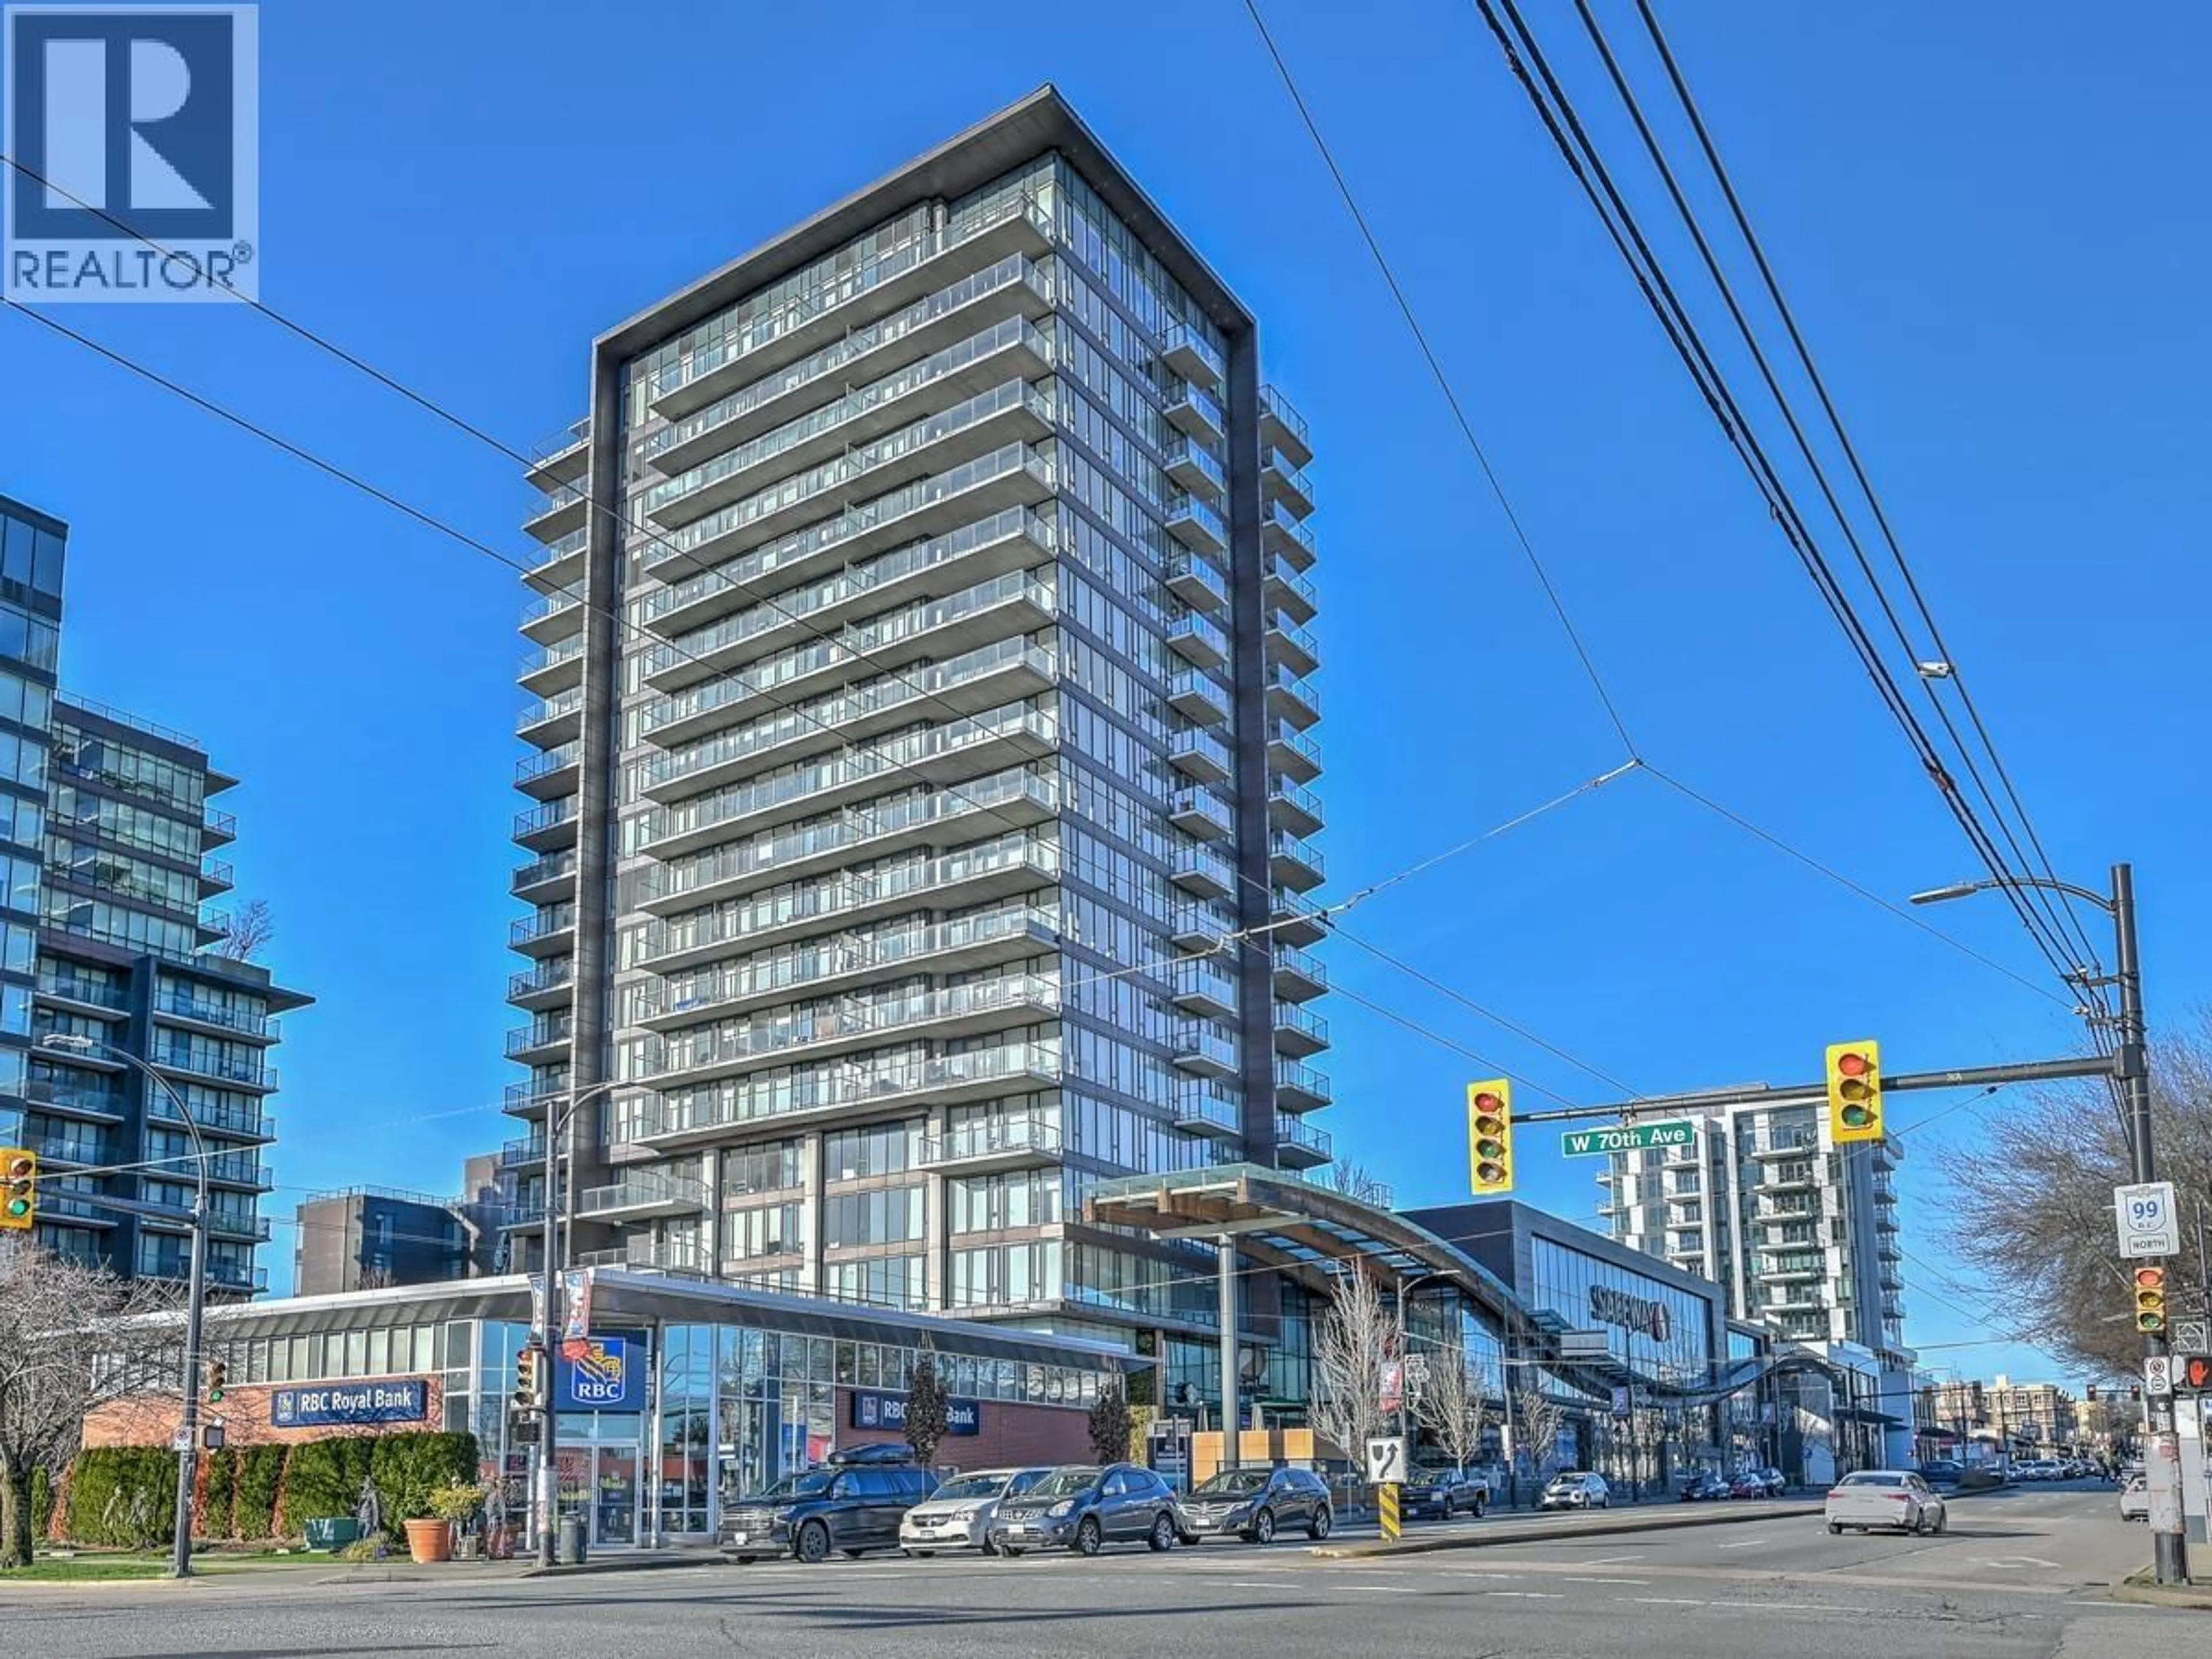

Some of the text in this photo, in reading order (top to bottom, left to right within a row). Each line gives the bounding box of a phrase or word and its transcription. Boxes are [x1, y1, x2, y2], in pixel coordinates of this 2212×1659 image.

[1571, 1128, 1685, 1152] W 70th Ave
[2133, 1200, 2158, 1219] 99
[2133, 1240, 2165, 1249] NORTH
[301, 1387, 412, 1414] RBC Royal Bank
[578, 1383, 620, 1398] RBC
[885, 1401, 975, 1425] RBC Bank
